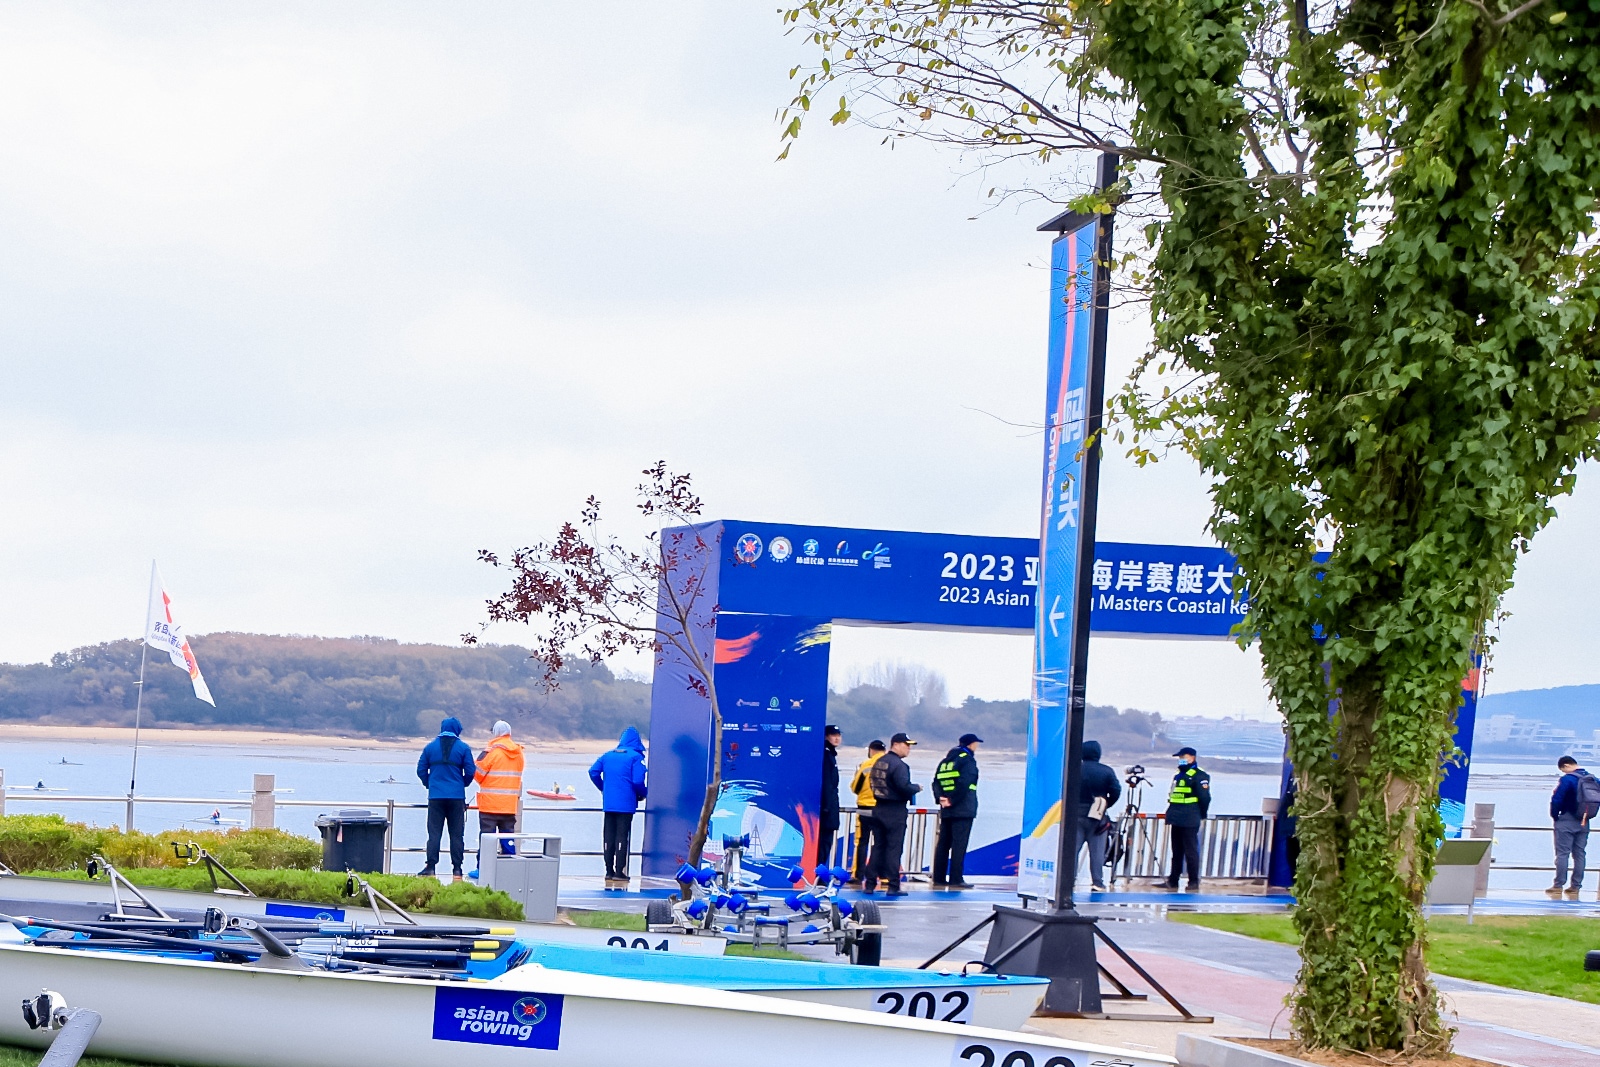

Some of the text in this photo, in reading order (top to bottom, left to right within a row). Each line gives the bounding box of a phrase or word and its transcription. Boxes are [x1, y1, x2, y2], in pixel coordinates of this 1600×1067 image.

[941, 552, 1015, 582] 2023
[939, 585, 980, 604] 2023
[984, 590, 1030, 606] Asian
[1099, 594, 1163, 612] Masters
[1167, 596, 1226, 615] Coastal
[454, 1006, 509, 1022] asian
[877, 990, 970, 1025] 202
[460, 1020, 533, 1041] rowing
